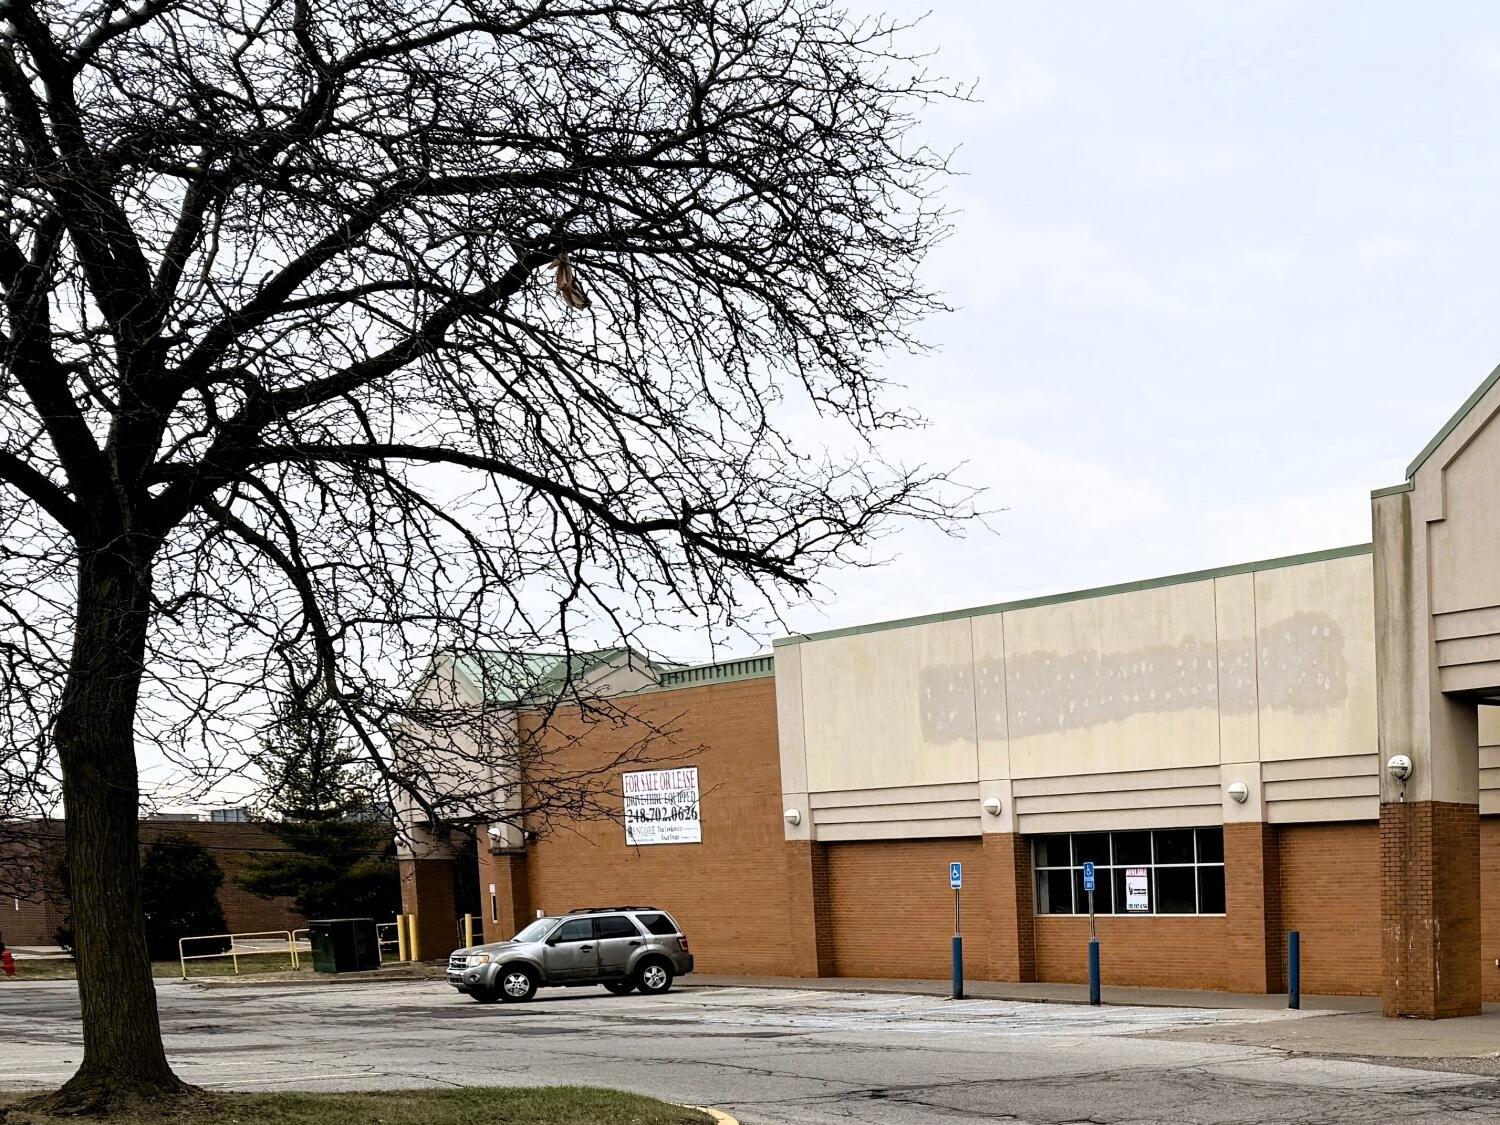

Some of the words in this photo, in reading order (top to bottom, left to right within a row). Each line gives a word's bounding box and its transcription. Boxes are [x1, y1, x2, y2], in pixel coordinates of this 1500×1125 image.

[625, 775, 641, 793] FOR
[641, 773, 659, 792] SALE
[660, 772, 672, 790] OR
[672, 770, 696, 789] LEASE
[627, 805, 698, 823] 248.702.0626
